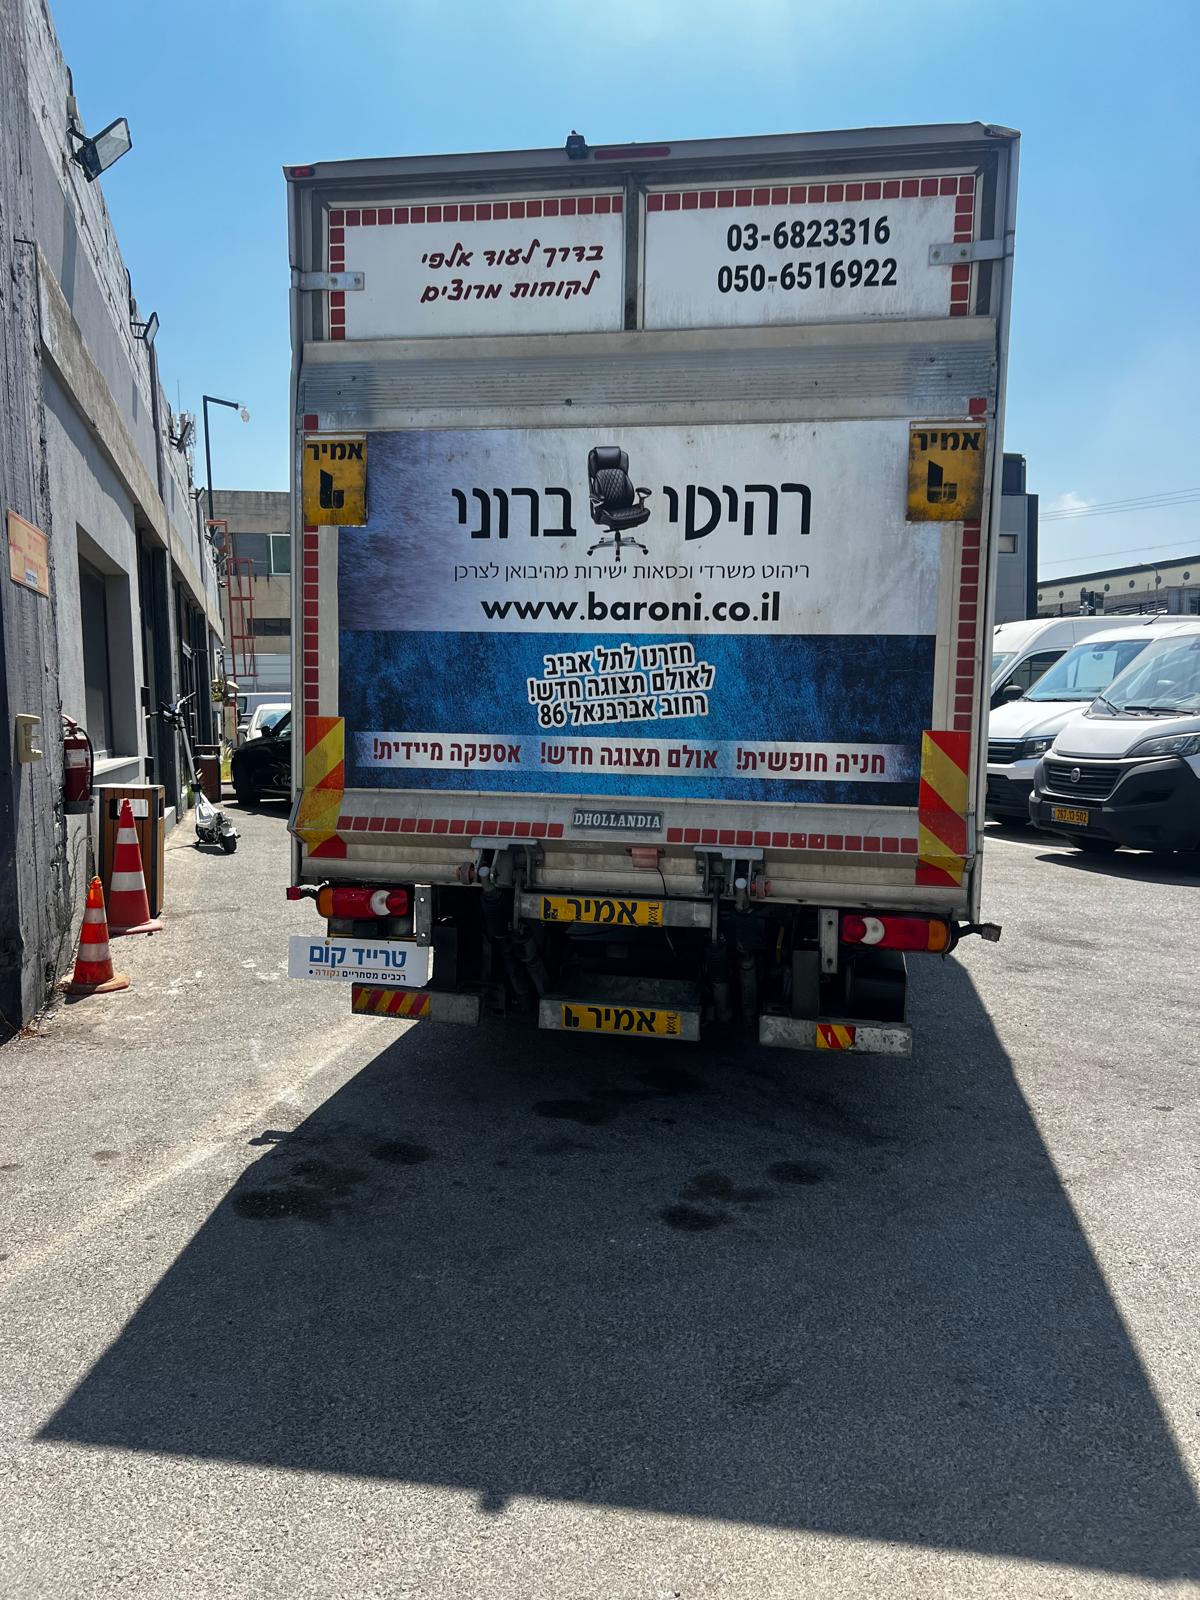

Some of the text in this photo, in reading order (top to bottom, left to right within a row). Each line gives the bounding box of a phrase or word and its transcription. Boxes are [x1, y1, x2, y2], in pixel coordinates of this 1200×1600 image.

[727, 216, 891, 251] 03-6823316
[421, 238, 604, 269] בדרך לעוד אלפי
[420, 269, 601, 304] לקוחות מרוצים
[717, 258, 897, 293] 050-6516922
[306, 443, 364, 460] אמיר
[913, 432, 981, 451] אמיר
[451, 482, 812, 541] רהיטי ברוני
[453, 562, 810, 582] ריהוט משרדי וכסאות ישירות מהיבואן לצרכן
[480, 591, 781, 622] www.baroni.co.il
[545, 645, 693, 676] חזרנו לתל אביב
[529, 664, 714, 702] לאולם תצוגה חדש!
[540, 694, 707, 726] רחוב אברבנאל 86
[373, 737, 522, 767] אספקה מיידית!
[540, 742, 718, 769] אולם תצוגה חדש!
[736, 747, 886, 774] חניה חופשית!
[573, 813, 661, 828] DHOLLANDIA
[567, 899, 638, 925] אמיר
[309, 945, 407, 968] טרייד קום
[315, 968, 407, 981] רכבים מסחריים נקודה
[588, 1006, 657, 1032] אמיר
